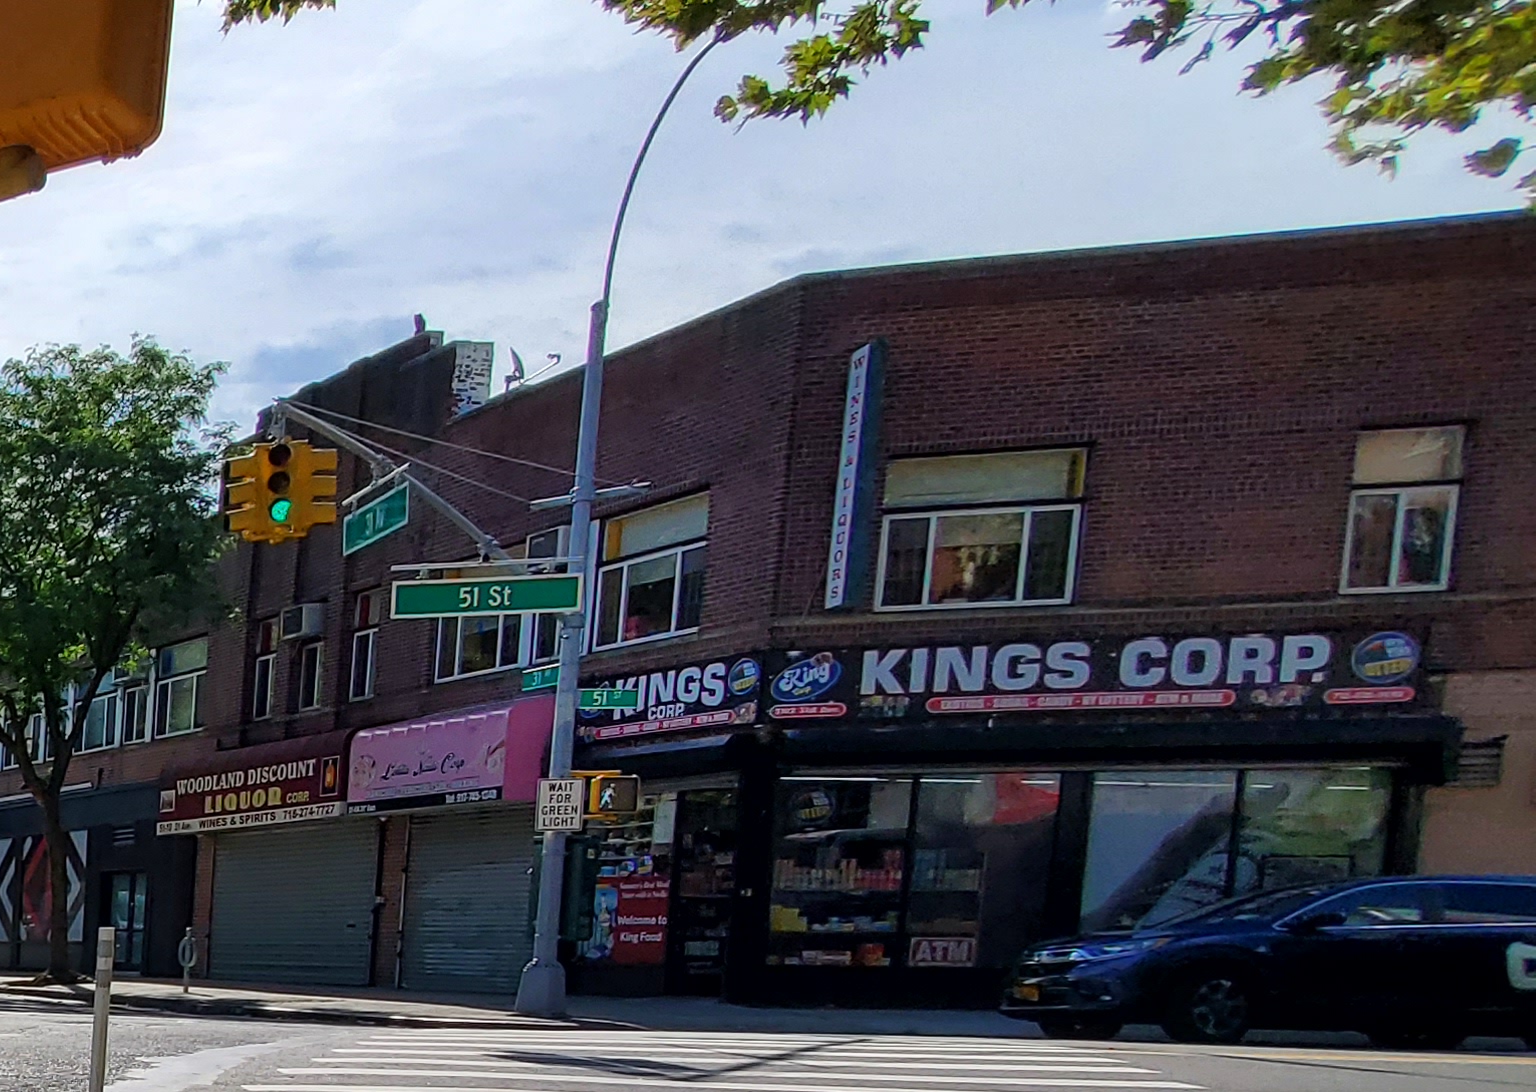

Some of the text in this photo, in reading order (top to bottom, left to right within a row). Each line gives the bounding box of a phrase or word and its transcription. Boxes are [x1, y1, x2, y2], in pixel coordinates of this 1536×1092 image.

[846, 354, 865, 444] WINES
[458, 585, 512, 608] 51 St
[778, 662, 830, 692] King
[860, 642, 1092, 695] KINGS
[532, 672, 542, 687] 31
[592, 692, 608, 707] 51
[612, 662, 726, 721] KINGS
[176, 758, 318, 796] WOODLAND DISCOUNT
[548, 781, 575, 793] WAIT
[203, 786, 282, 814] LIQUOR
[548, 793, 572, 805] FOR
[541, 804, 578, 816] GREEN
[198, 815, 227, 829] WINES
[229, 815, 237, 826] &
[239, 811, 277, 825] SPIRITS
[542, 816, 576, 828] LIGHT
[617, 914, 668, 925] Welcome to
[619, 931, 639, 944] King
[915, 940, 970, 962] ATM
